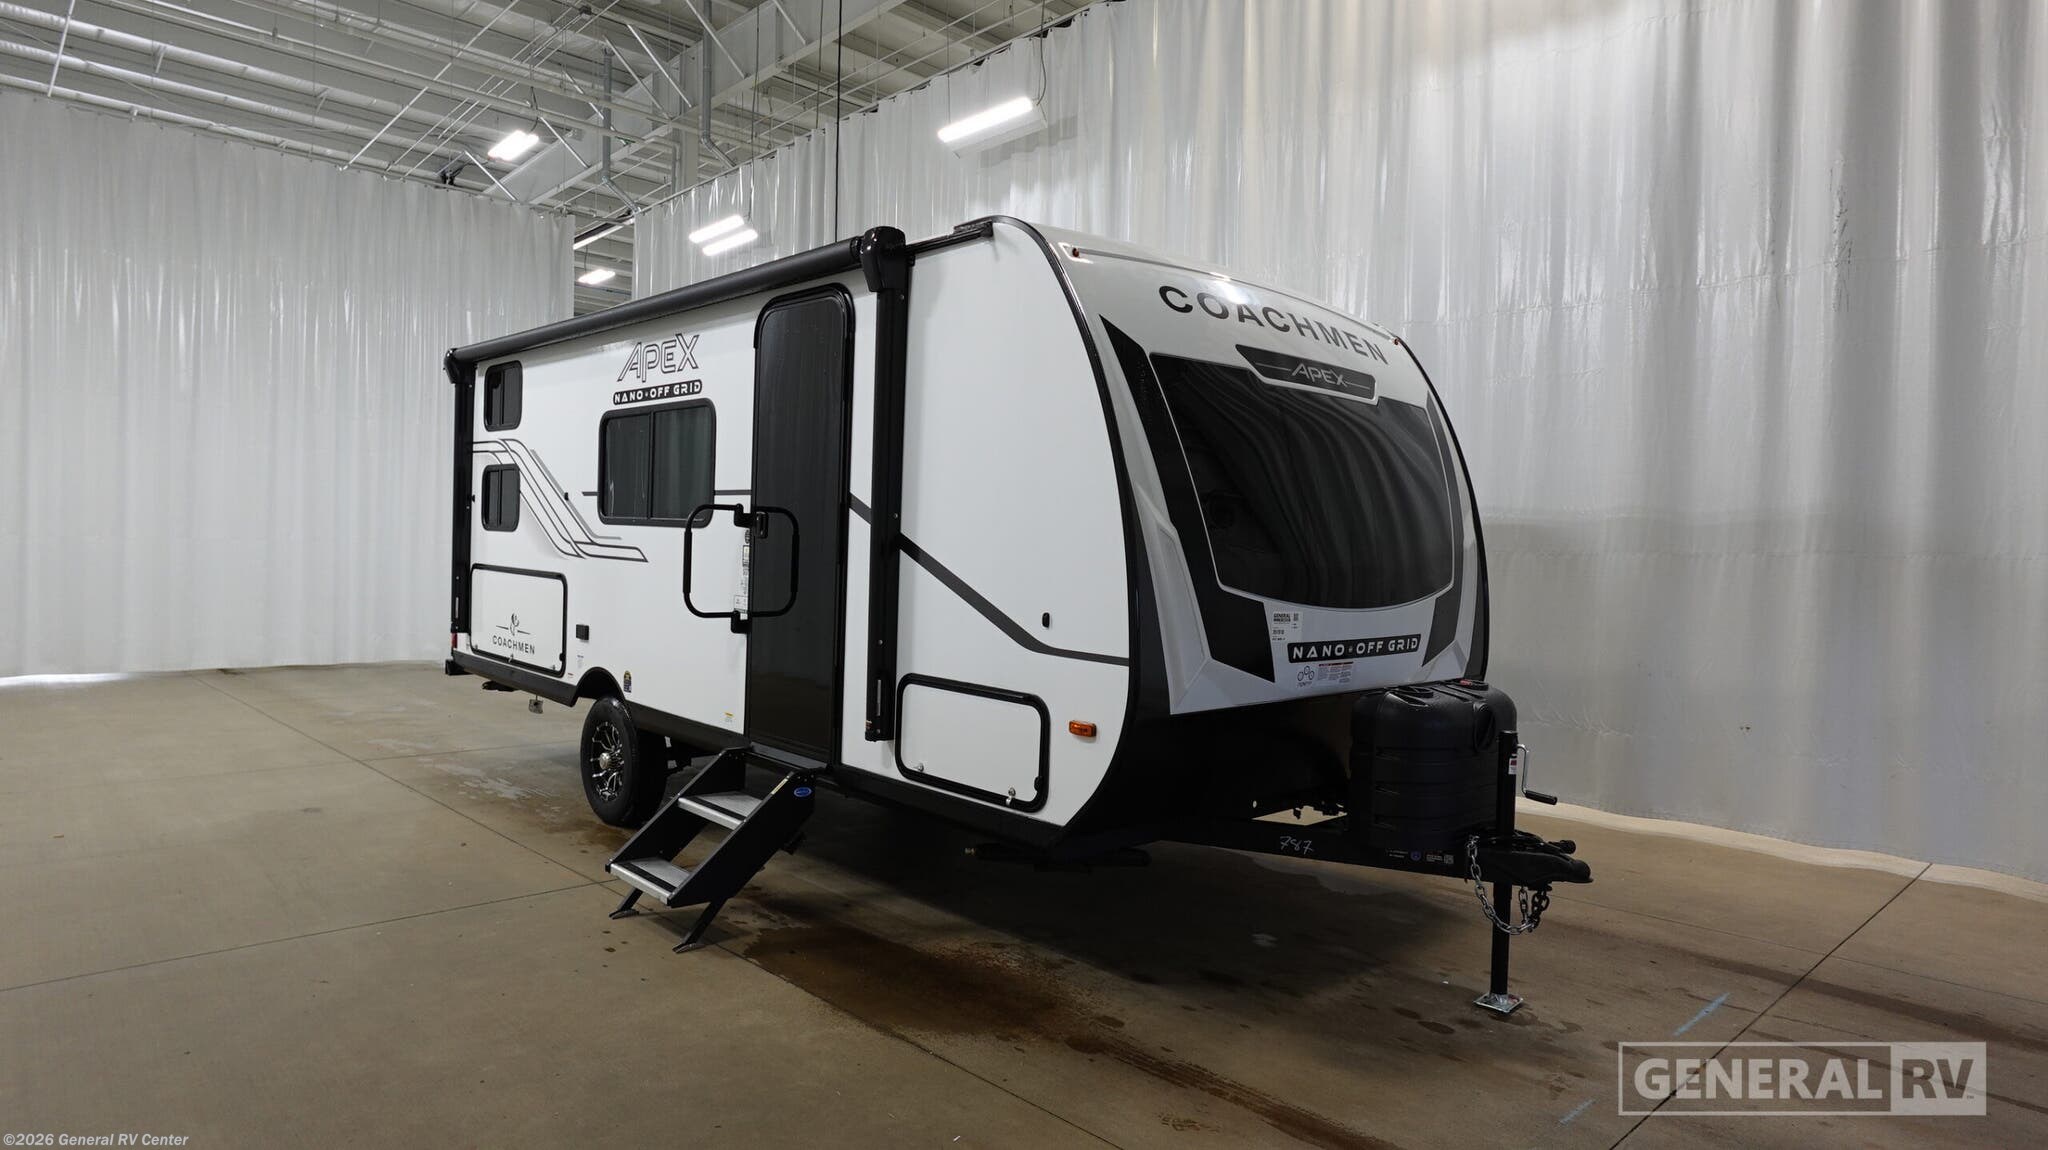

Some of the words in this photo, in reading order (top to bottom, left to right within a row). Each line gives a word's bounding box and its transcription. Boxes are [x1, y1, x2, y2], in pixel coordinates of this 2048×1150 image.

[1158, 285, 1389, 365] COACHMEN
[617, 333, 700, 383] APEX
[1291, 362, 1348, 388] APEX
[673, 381, 701, 396] GRID
[492, 635, 536, 655] COACHMEN
[1388, 638, 1418, 651] GRID
[1280, 836, 1314, 855] 787
